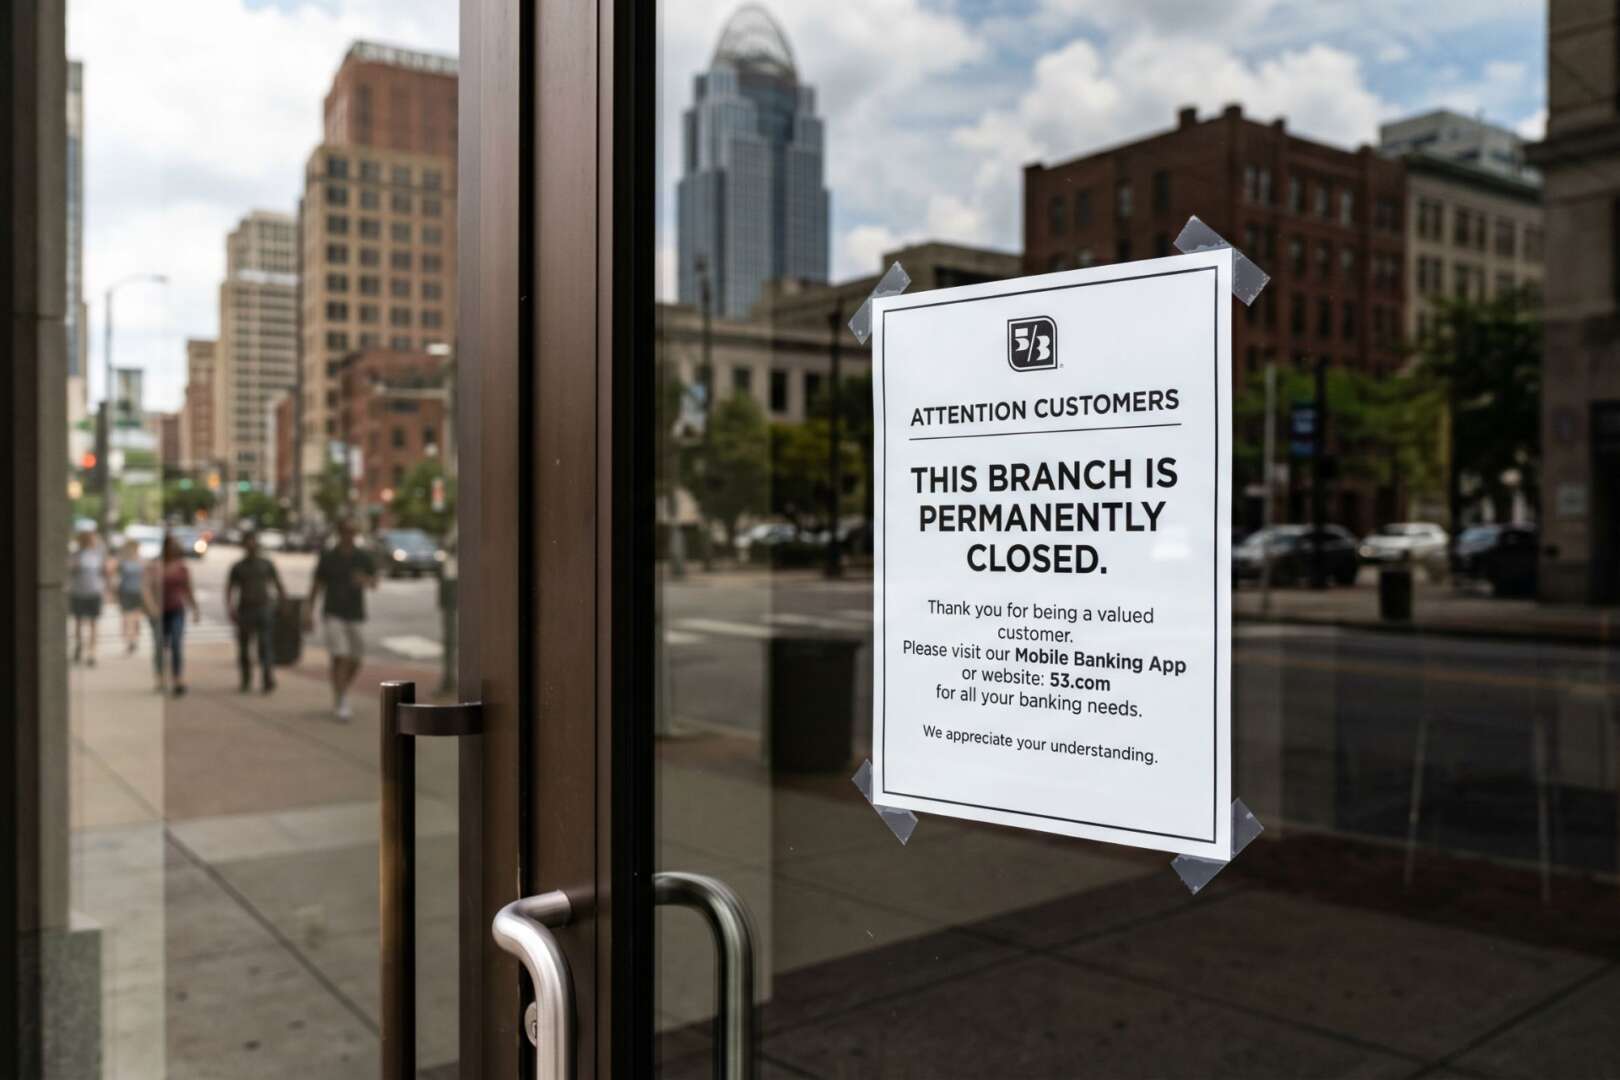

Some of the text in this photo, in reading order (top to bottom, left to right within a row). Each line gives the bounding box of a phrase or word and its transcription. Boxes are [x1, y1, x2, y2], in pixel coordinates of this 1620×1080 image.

[911, 389, 1179, 426] ATTENTION CUSTOMERS
[911, 457, 1177, 493] THIS BRANCH IS
[920, 501, 1166, 532] PERMANENTLY
[967, 544, 1107, 574] CLOSED.
[928, 600, 1153, 623] Thank you for being a valued
[998, 626, 1072, 643] customer.
[904, 640, 1186, 676] Please visit our Mobile Banking App
[962, 668, 1110, 691] or website: 53.com
[936, 684, 1142, 717] for all your banking needs.
[923, 725, 1157, 765] We appreciate your understanding.
